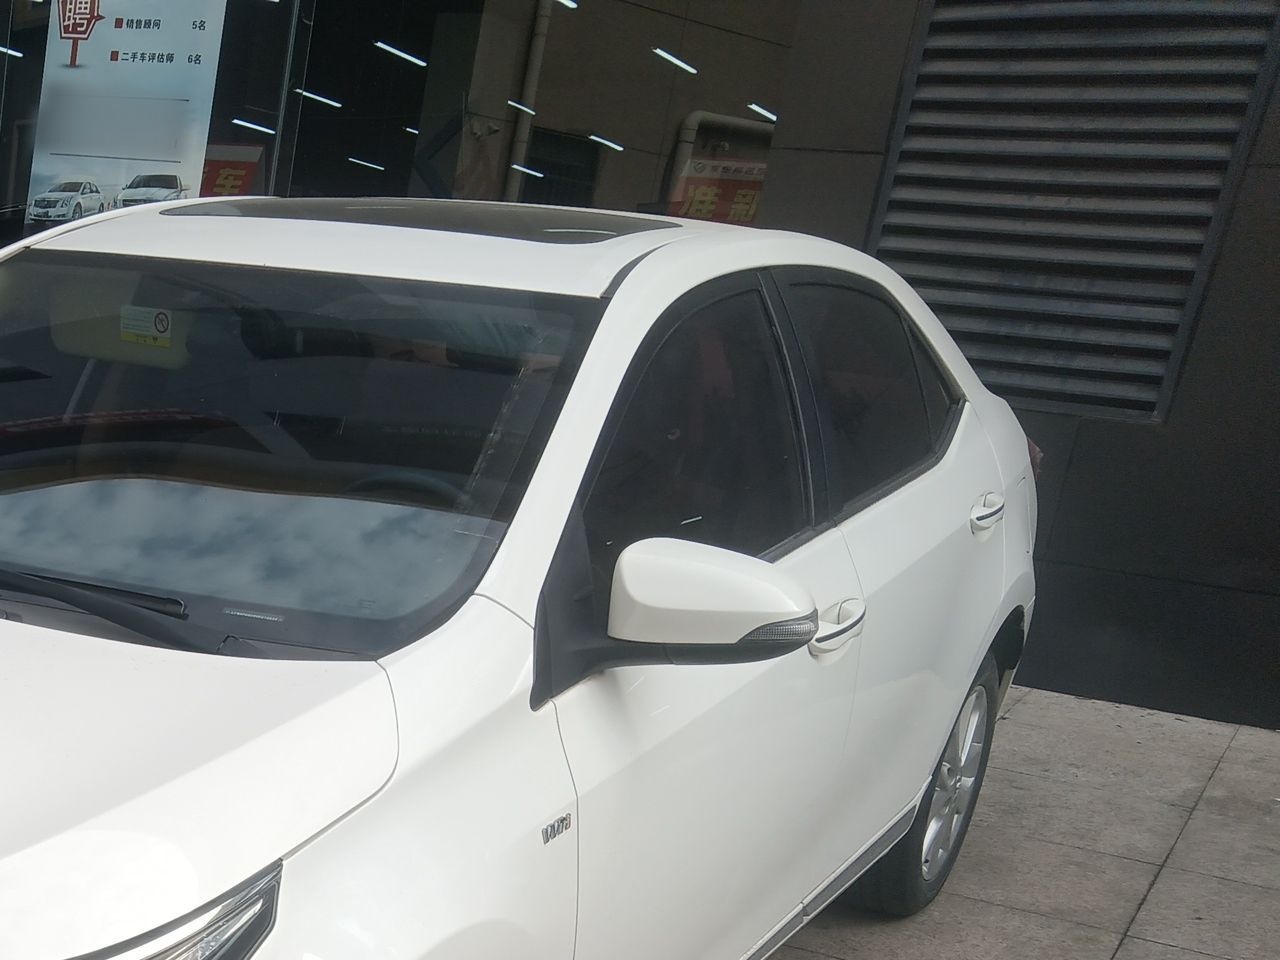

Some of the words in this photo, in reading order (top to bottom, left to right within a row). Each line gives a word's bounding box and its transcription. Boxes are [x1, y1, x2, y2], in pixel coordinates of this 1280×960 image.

[63, 0, 91, 31] 聘
[125, 18, 162, 30] 销售顾问
[192, 20, 207, 31] 5名
[120, 52, 175, 64] 二手车评估师
[187, 54, 202, 65] 6名
